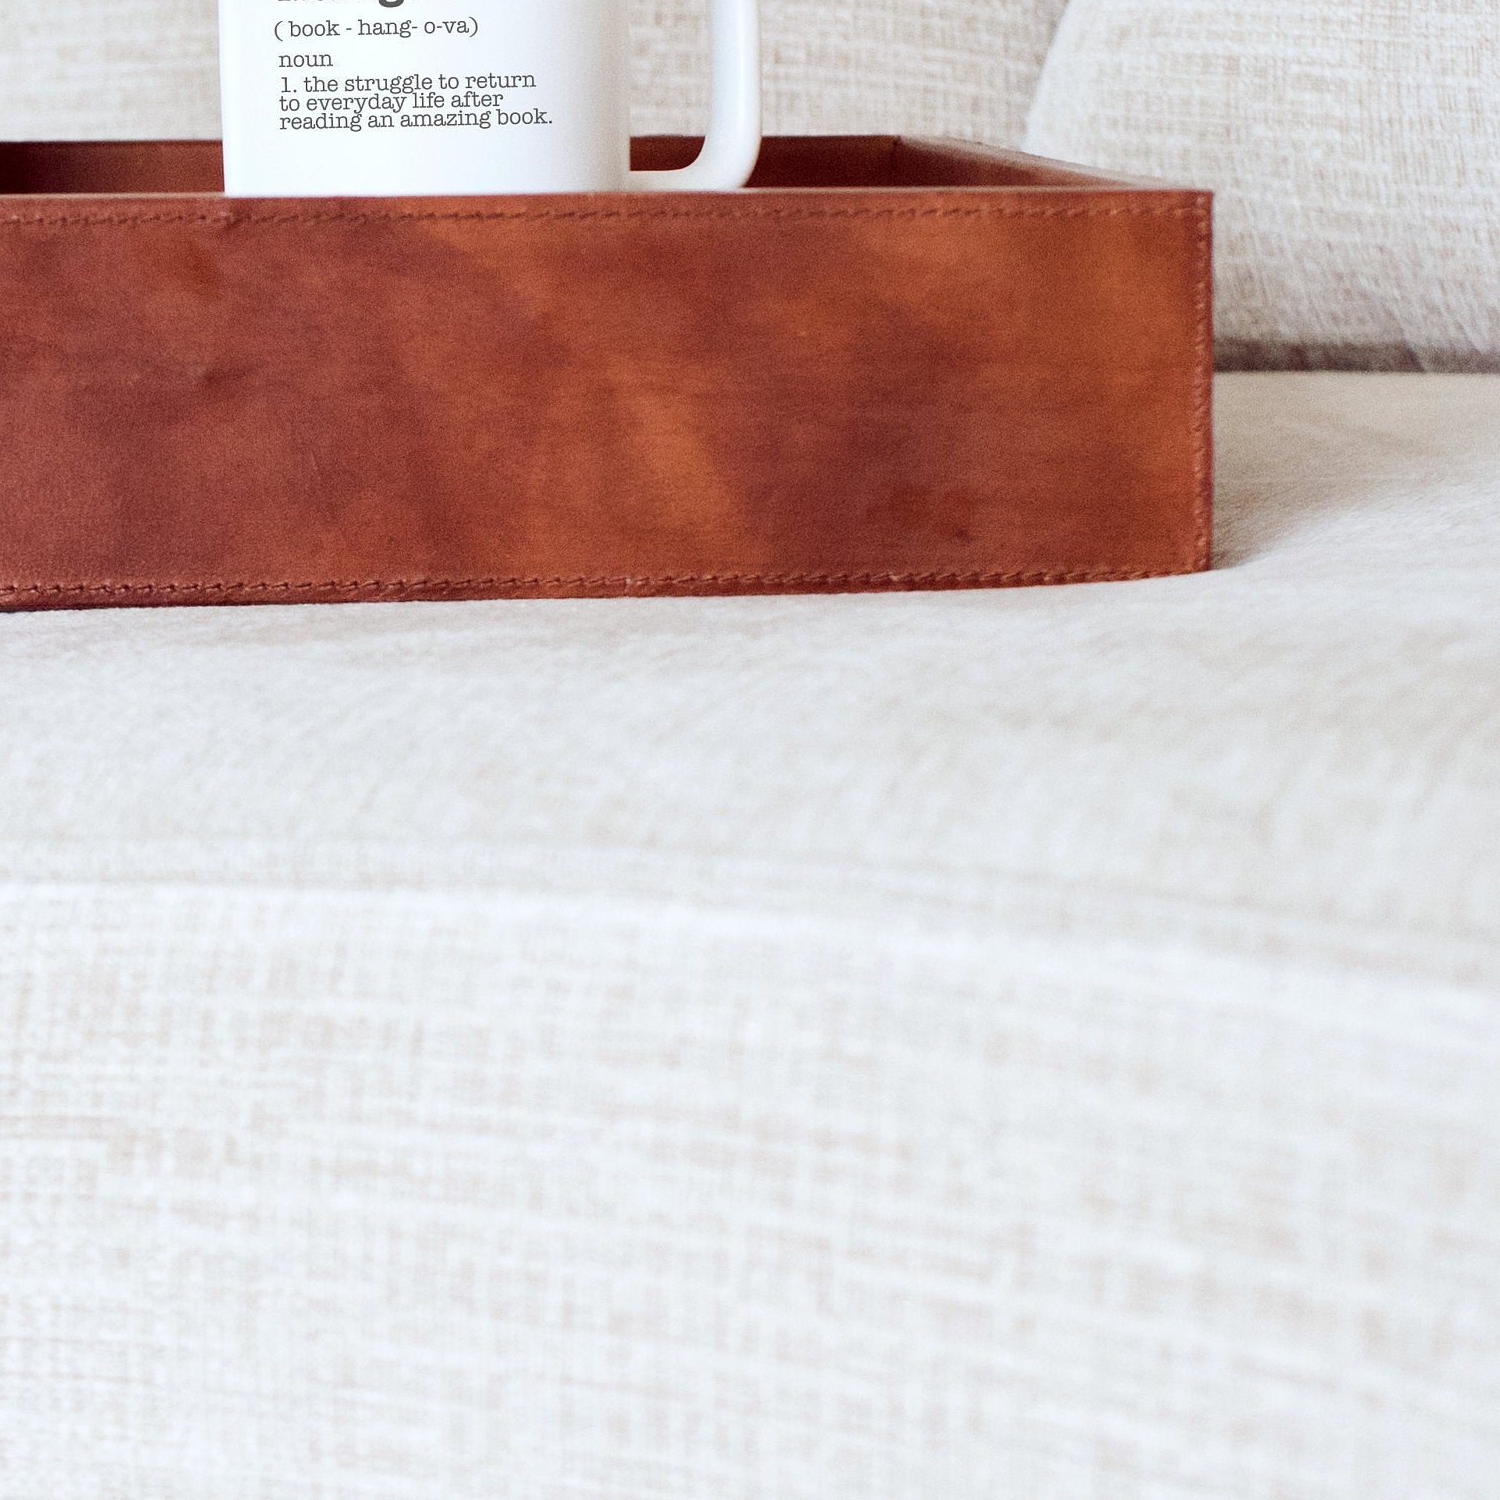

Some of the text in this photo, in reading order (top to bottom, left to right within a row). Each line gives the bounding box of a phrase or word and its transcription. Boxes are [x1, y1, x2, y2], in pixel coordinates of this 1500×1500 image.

[278, 53, 334, 68] noun
[280, 72, 537, 93] 1. the struggle to return
[279, 92, 504, 114] to everyday life after
[279, 107, 553, 132] reading an amazing book.
